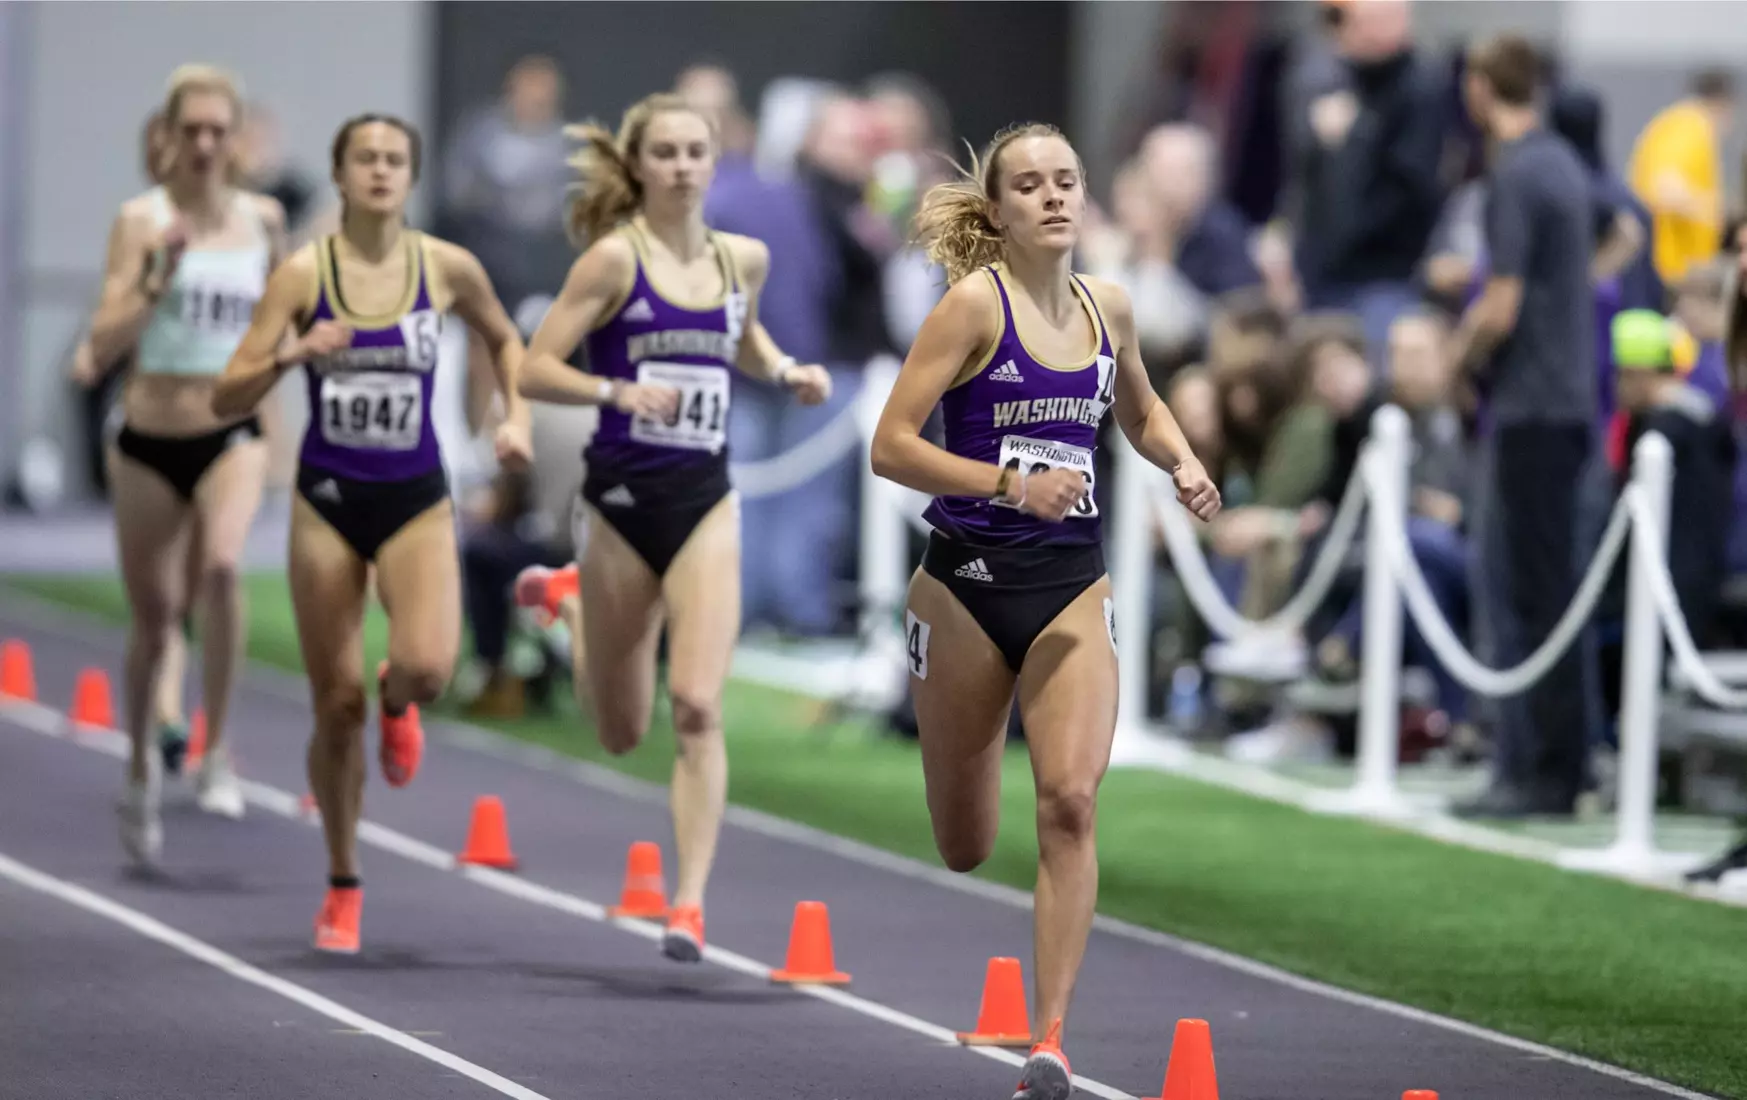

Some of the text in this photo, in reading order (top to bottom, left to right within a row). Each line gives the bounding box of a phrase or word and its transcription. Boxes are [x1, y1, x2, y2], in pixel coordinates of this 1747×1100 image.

[988, 373, 1024, 383] adidas
[330, 395, 415, 432] 1947
[1009, 440, 1087, 466] WASHINGTON
[954, 568, 994, 582] adidas
[908, 621, 923, 673] 4
